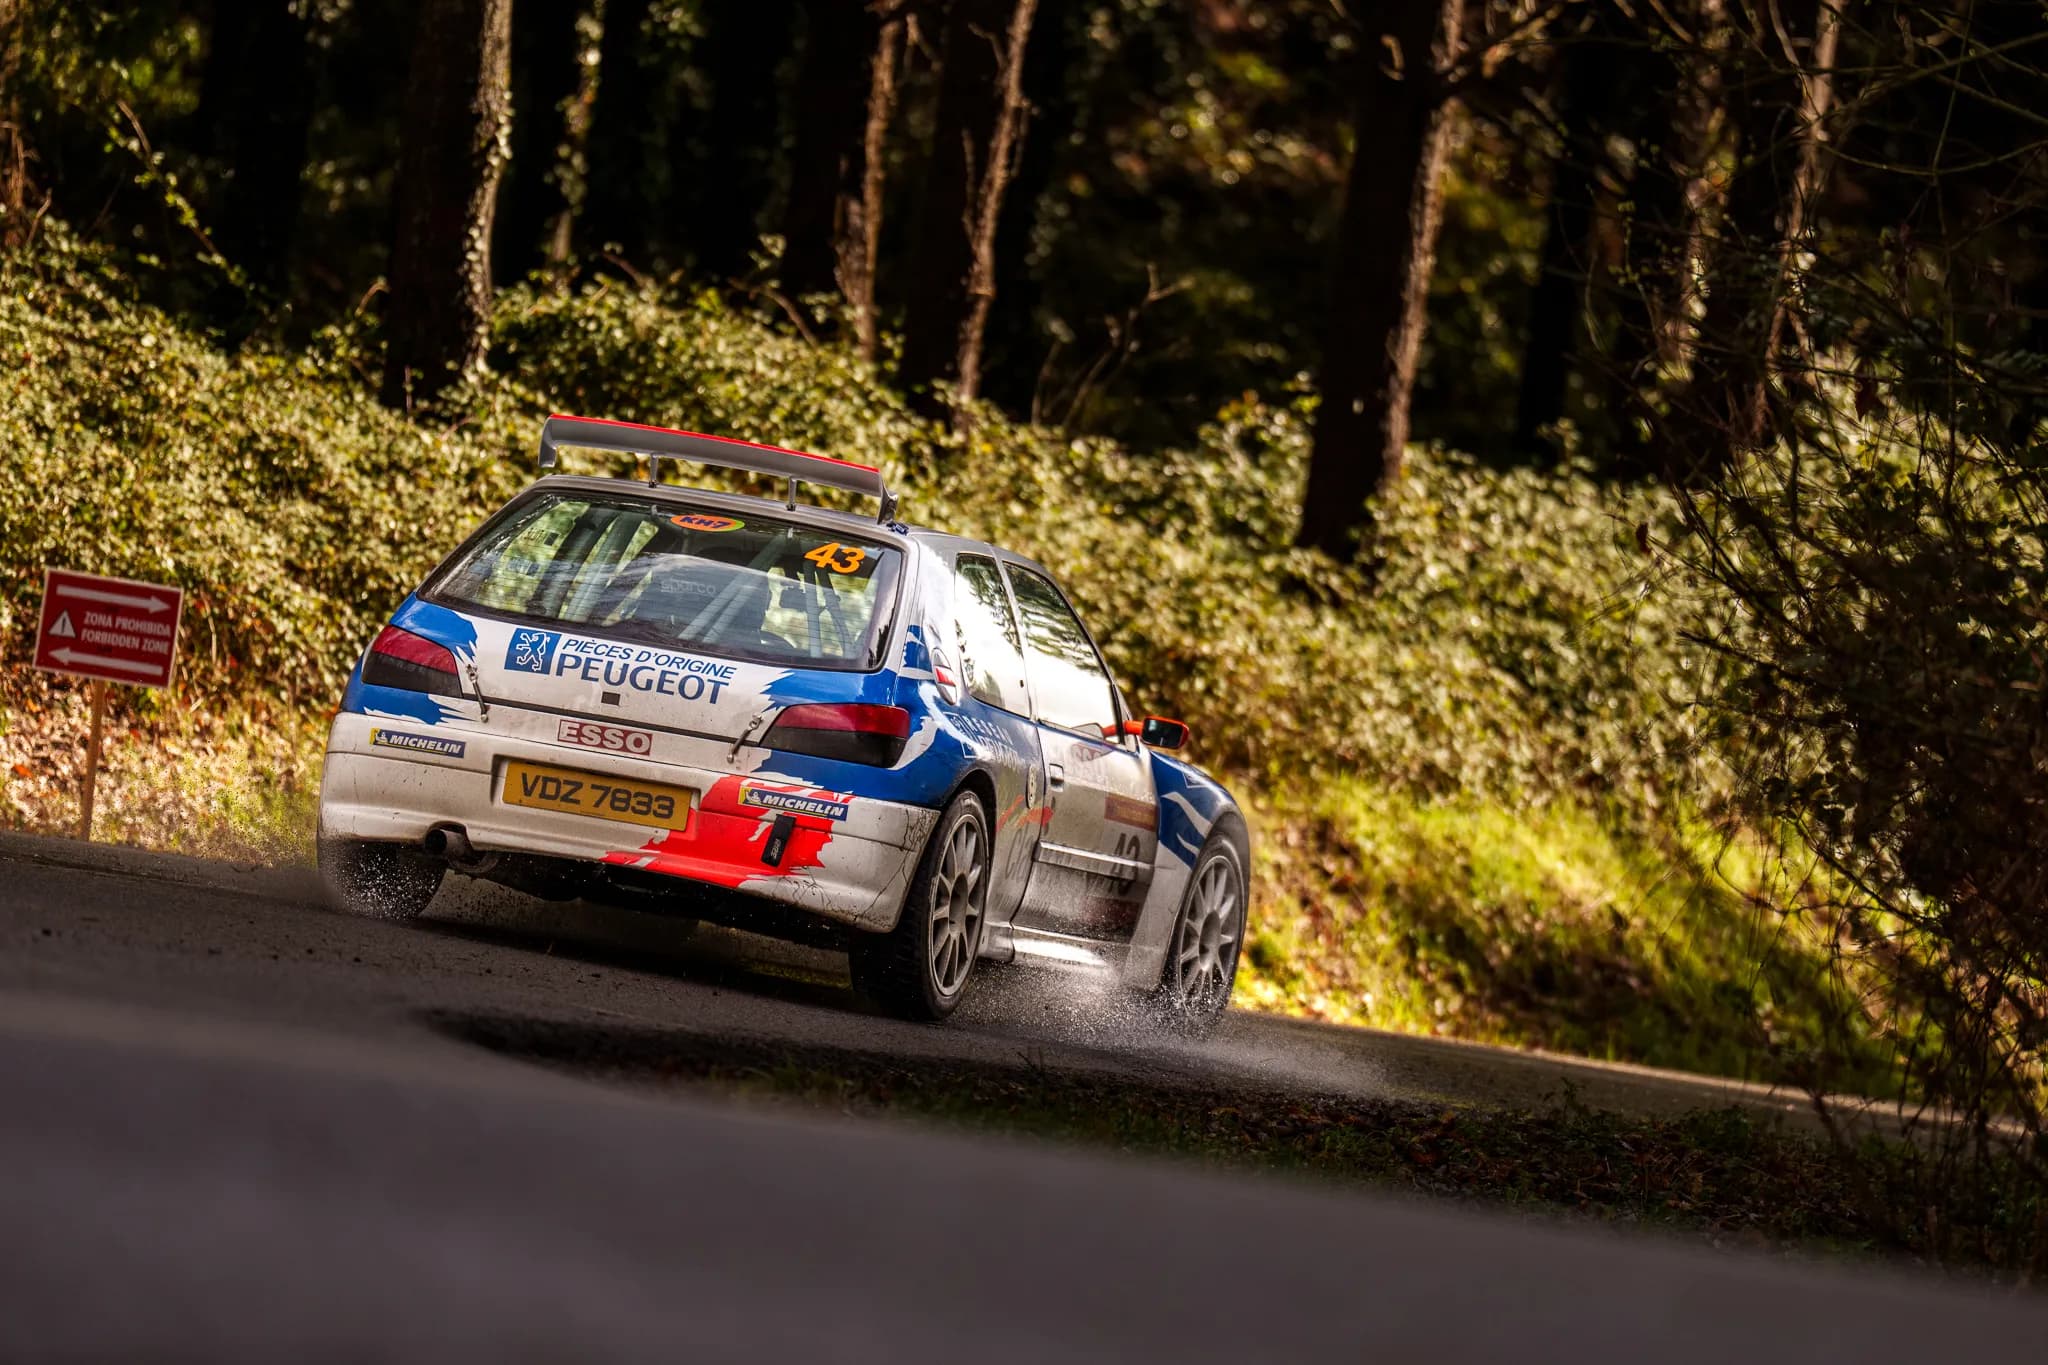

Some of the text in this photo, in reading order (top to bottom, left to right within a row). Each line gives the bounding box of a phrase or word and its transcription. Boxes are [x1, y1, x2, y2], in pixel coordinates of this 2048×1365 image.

[804, 542, 866, 574] 43
[84, 612, 171, 636] ZONA PROHIBIDA
[81, 630, 170, 655] FORBIDDEN ZONE
[562, 636, 738, 680] PIÈCES D'ORIGINE
[555, 652, 730, 704] PEUGEOT
[388, 734, 463, 757] MICHELIN
[557, 720, 650, 754] ESSO
[520, 771, 676, 820] VDZ 7833
[762, 795, 844, 817] MICHELIN
